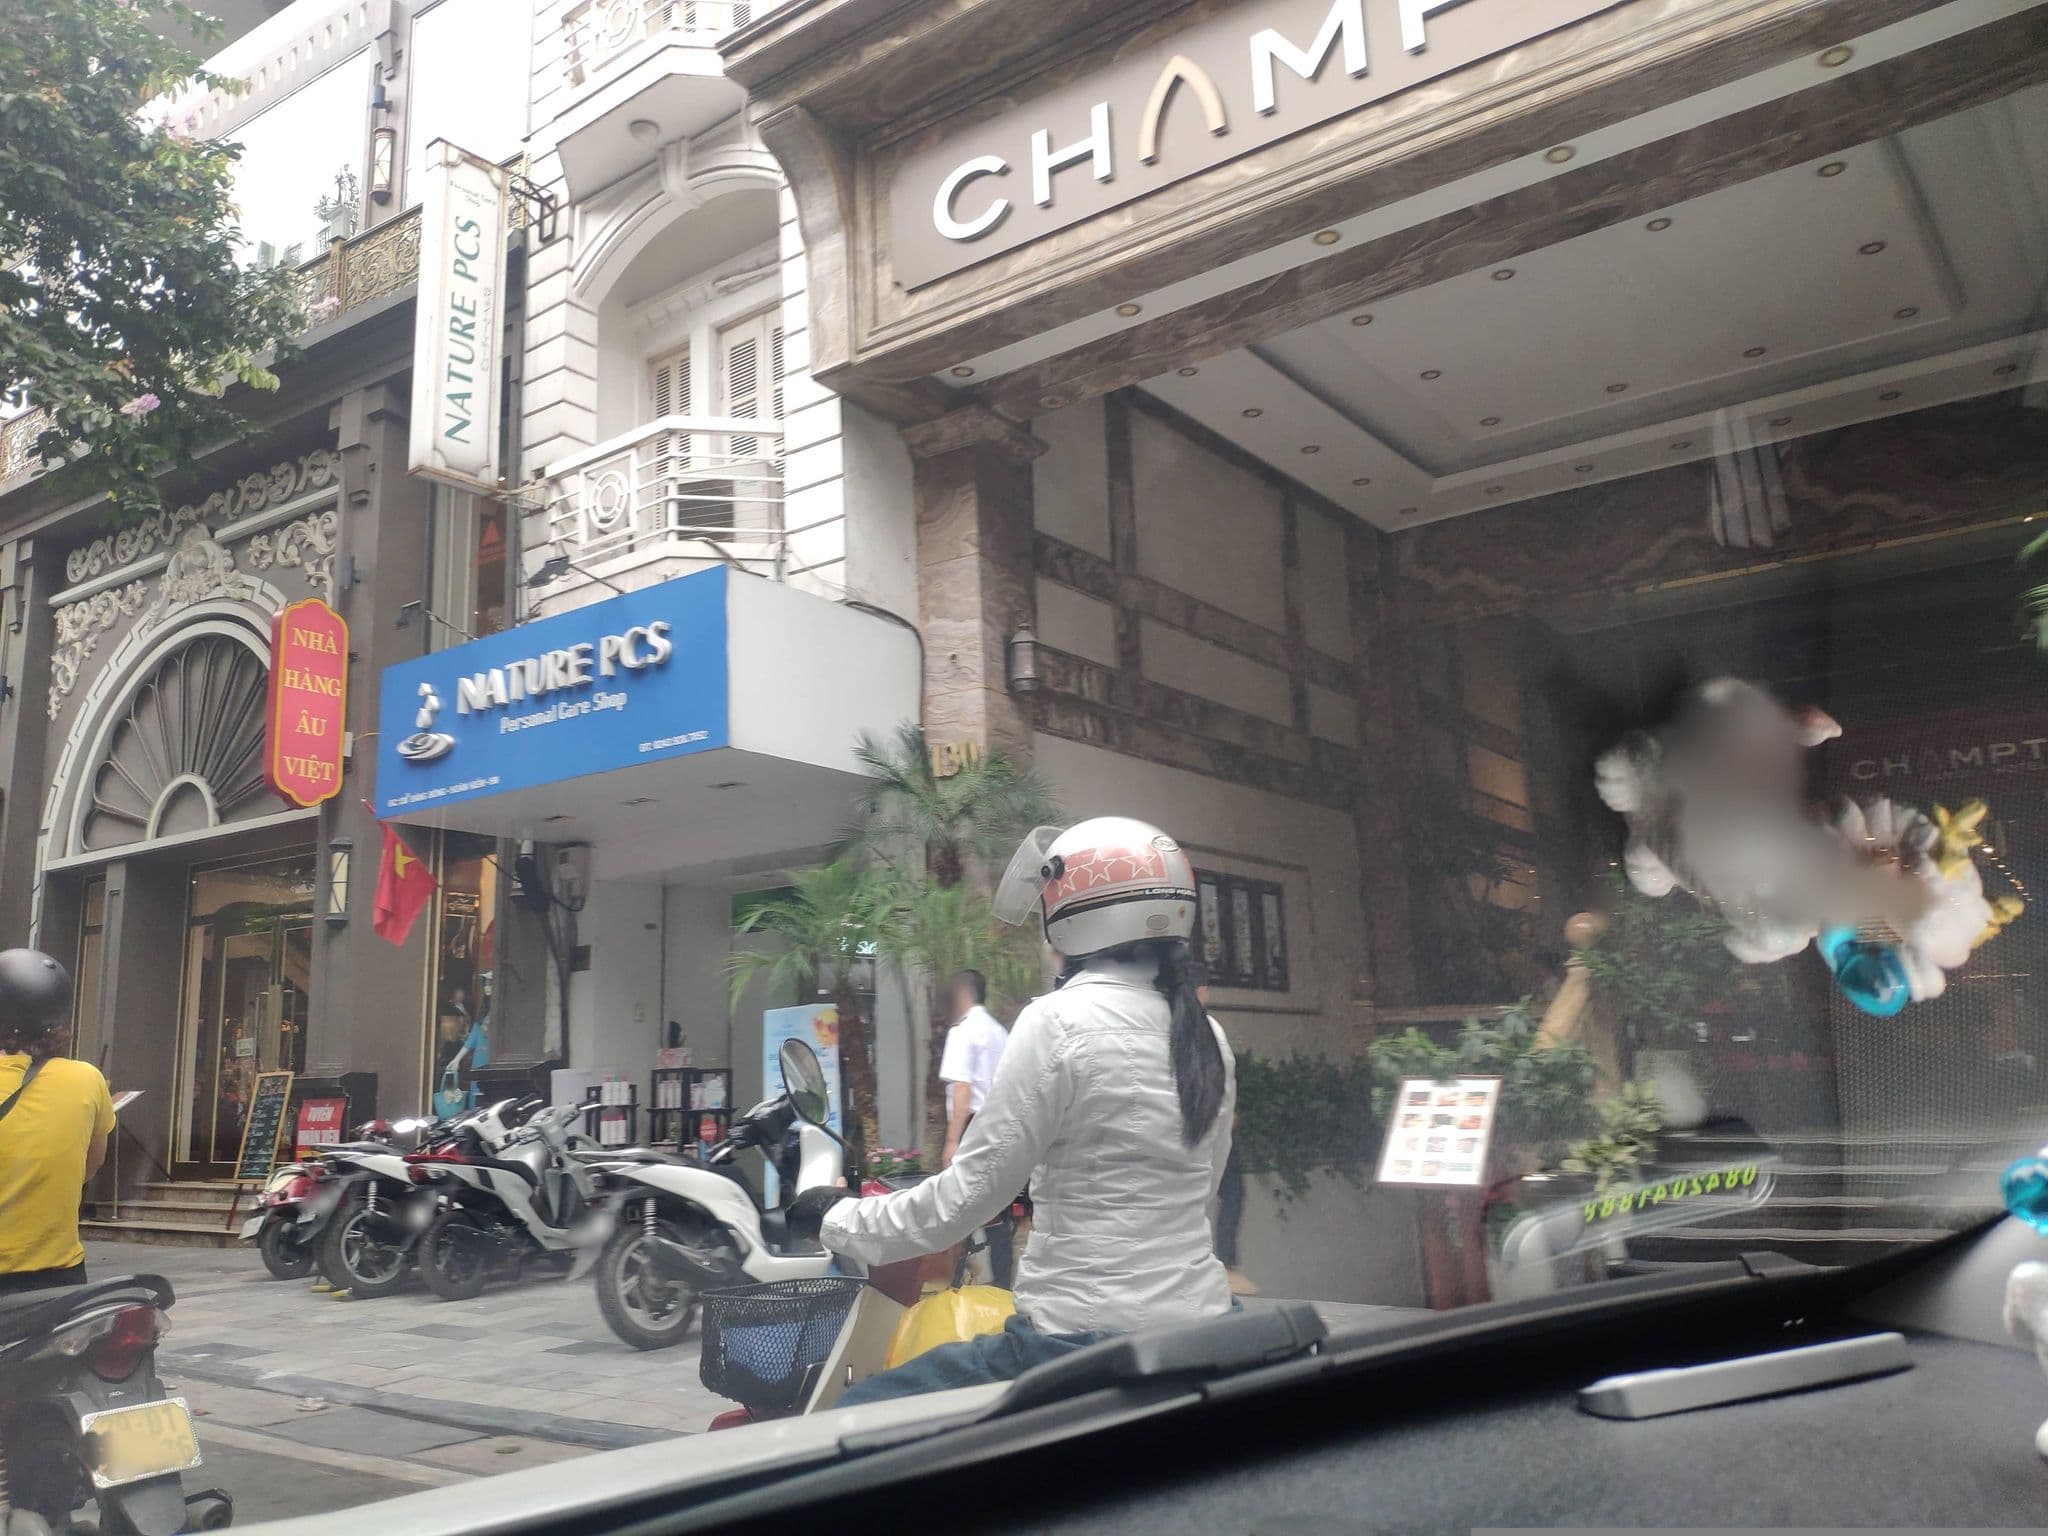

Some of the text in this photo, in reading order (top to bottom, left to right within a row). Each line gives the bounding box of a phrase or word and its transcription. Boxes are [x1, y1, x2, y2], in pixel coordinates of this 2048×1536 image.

[453, 216, 481, 283] PCS
[445, 291, 478, 444] NATURE
[291, 629, 339, 655] NHÀ
[283, 667, 342, 697] HÀNG
[457, 621, 673, 714] NATURE PCS
[295, 709, 327, 737] ÂU
[500, 691, 627, 735] Personal Care Shop
[282, 753, 335, 784] VIỆT
